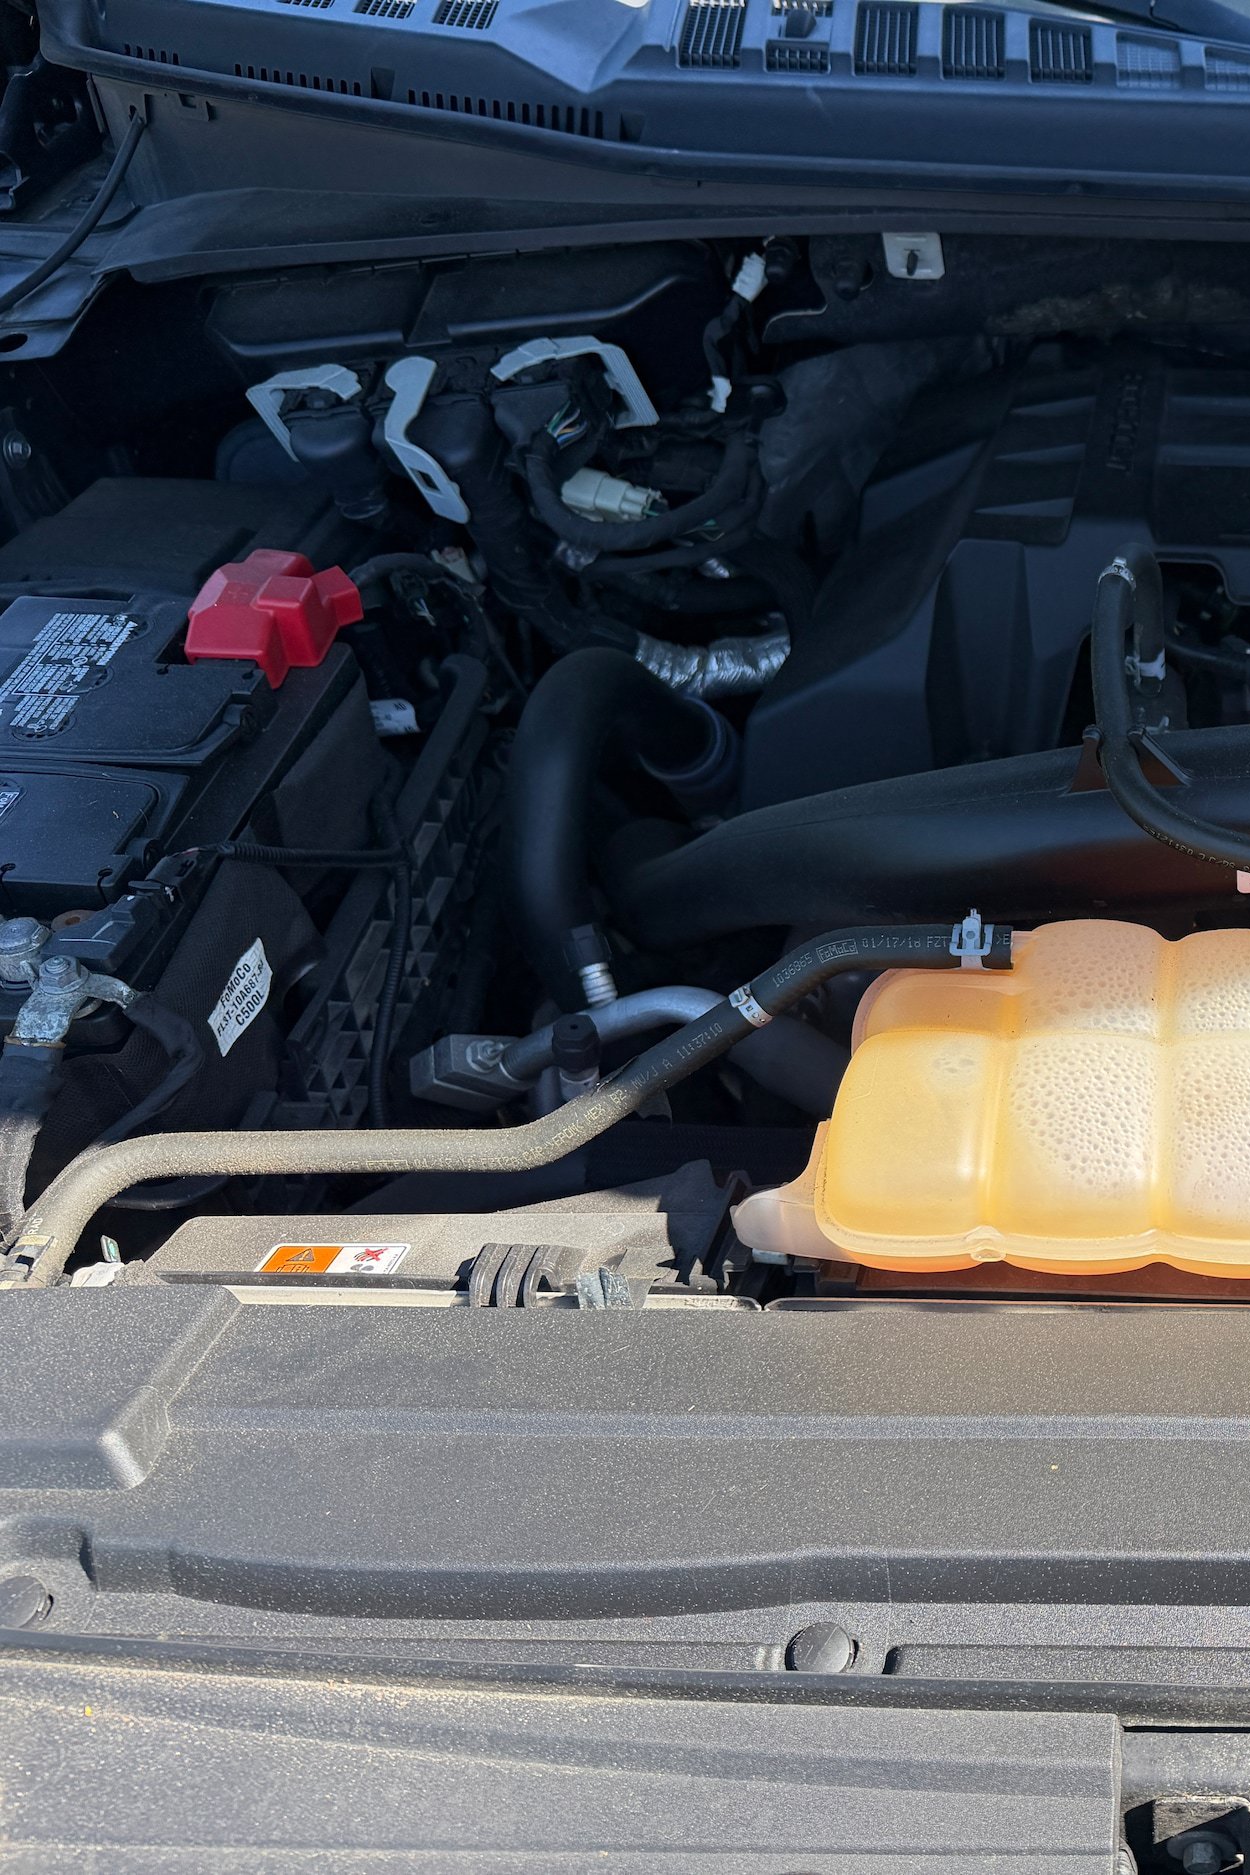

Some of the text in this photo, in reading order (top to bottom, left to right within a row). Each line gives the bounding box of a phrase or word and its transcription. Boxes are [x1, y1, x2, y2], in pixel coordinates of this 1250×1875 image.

[926, 935, 951, 948] FZT
[219, 963, 251, 1009] FoMoCo
[235, 989, 265, 1026] C500L
